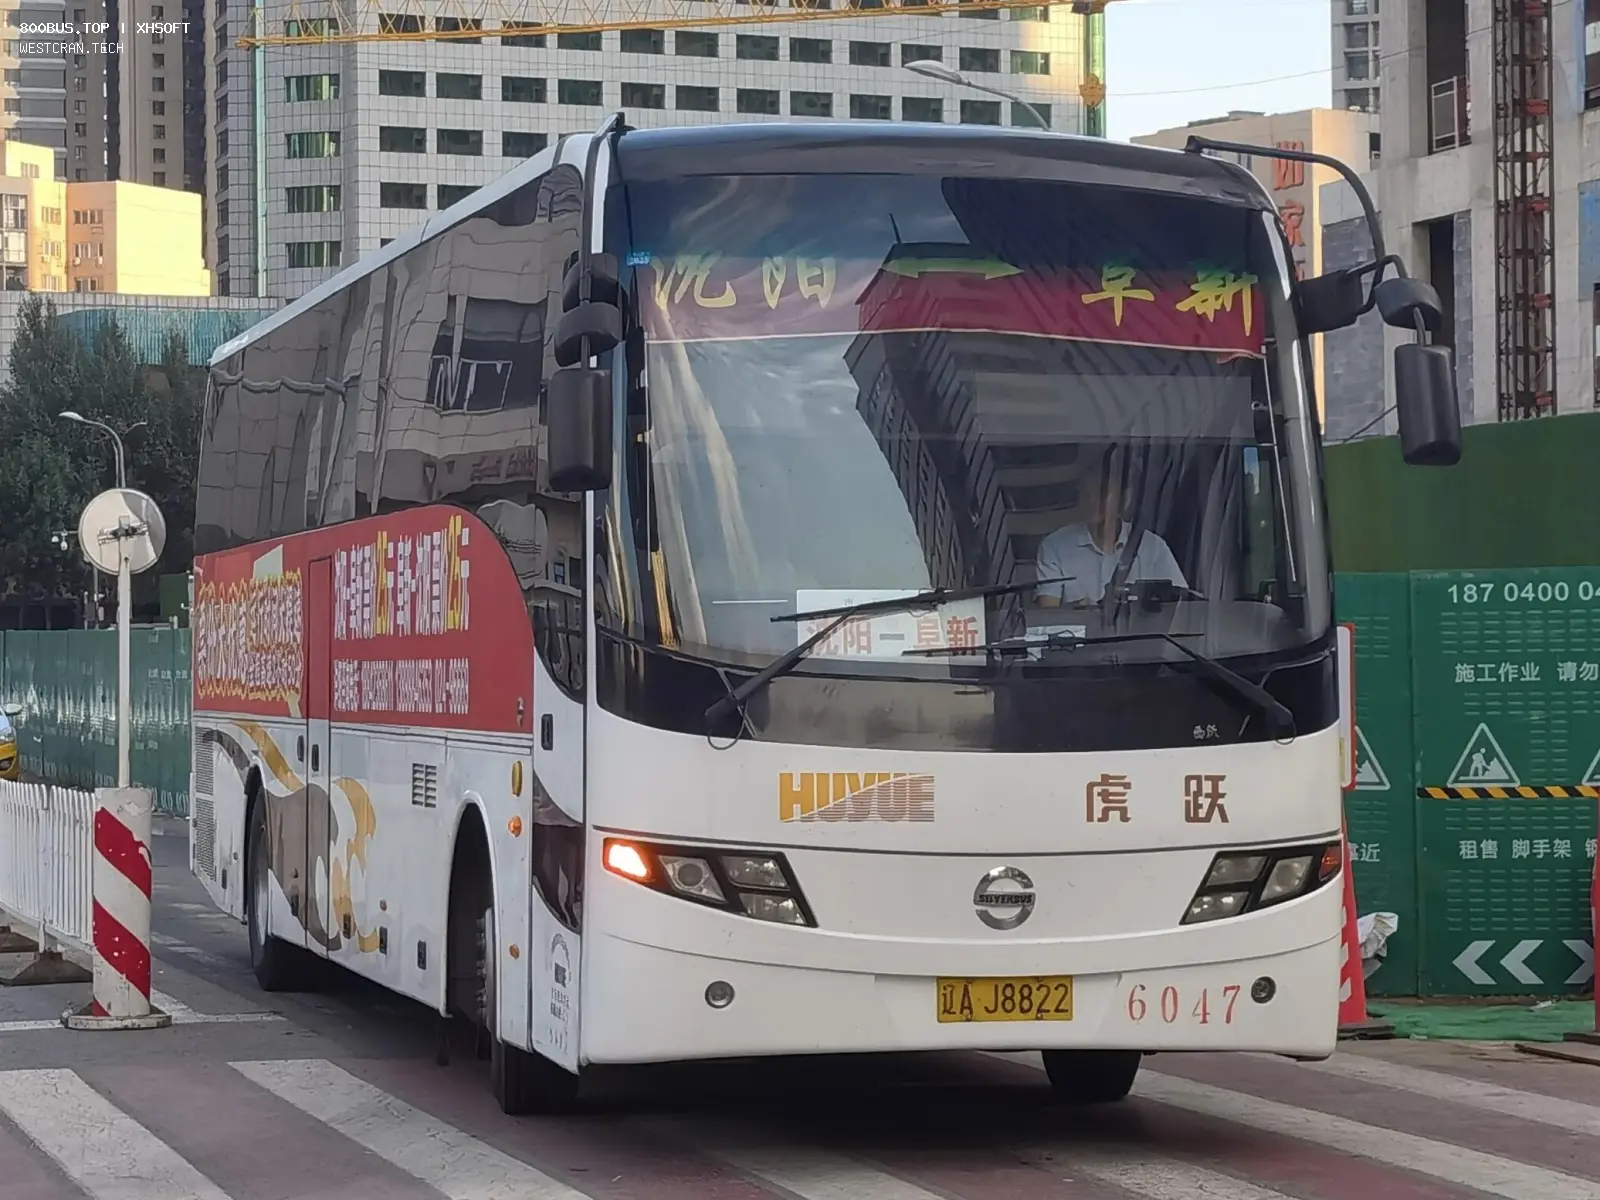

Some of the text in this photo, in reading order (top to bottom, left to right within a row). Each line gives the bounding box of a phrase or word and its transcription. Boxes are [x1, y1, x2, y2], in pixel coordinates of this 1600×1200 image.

[1447, 583, 1495, 604] 187
[1503, 581, 1570, 602] 0400
[1454, 661, 1599, 683] 施工作业 请勿
[1086, 773, 1230, 824] 虎跃
[1459, 839, 1499, 859] 租售
[1511, 838, 1572, 859] 脚手架
[1128, 984, 1241, 1025] 6047
